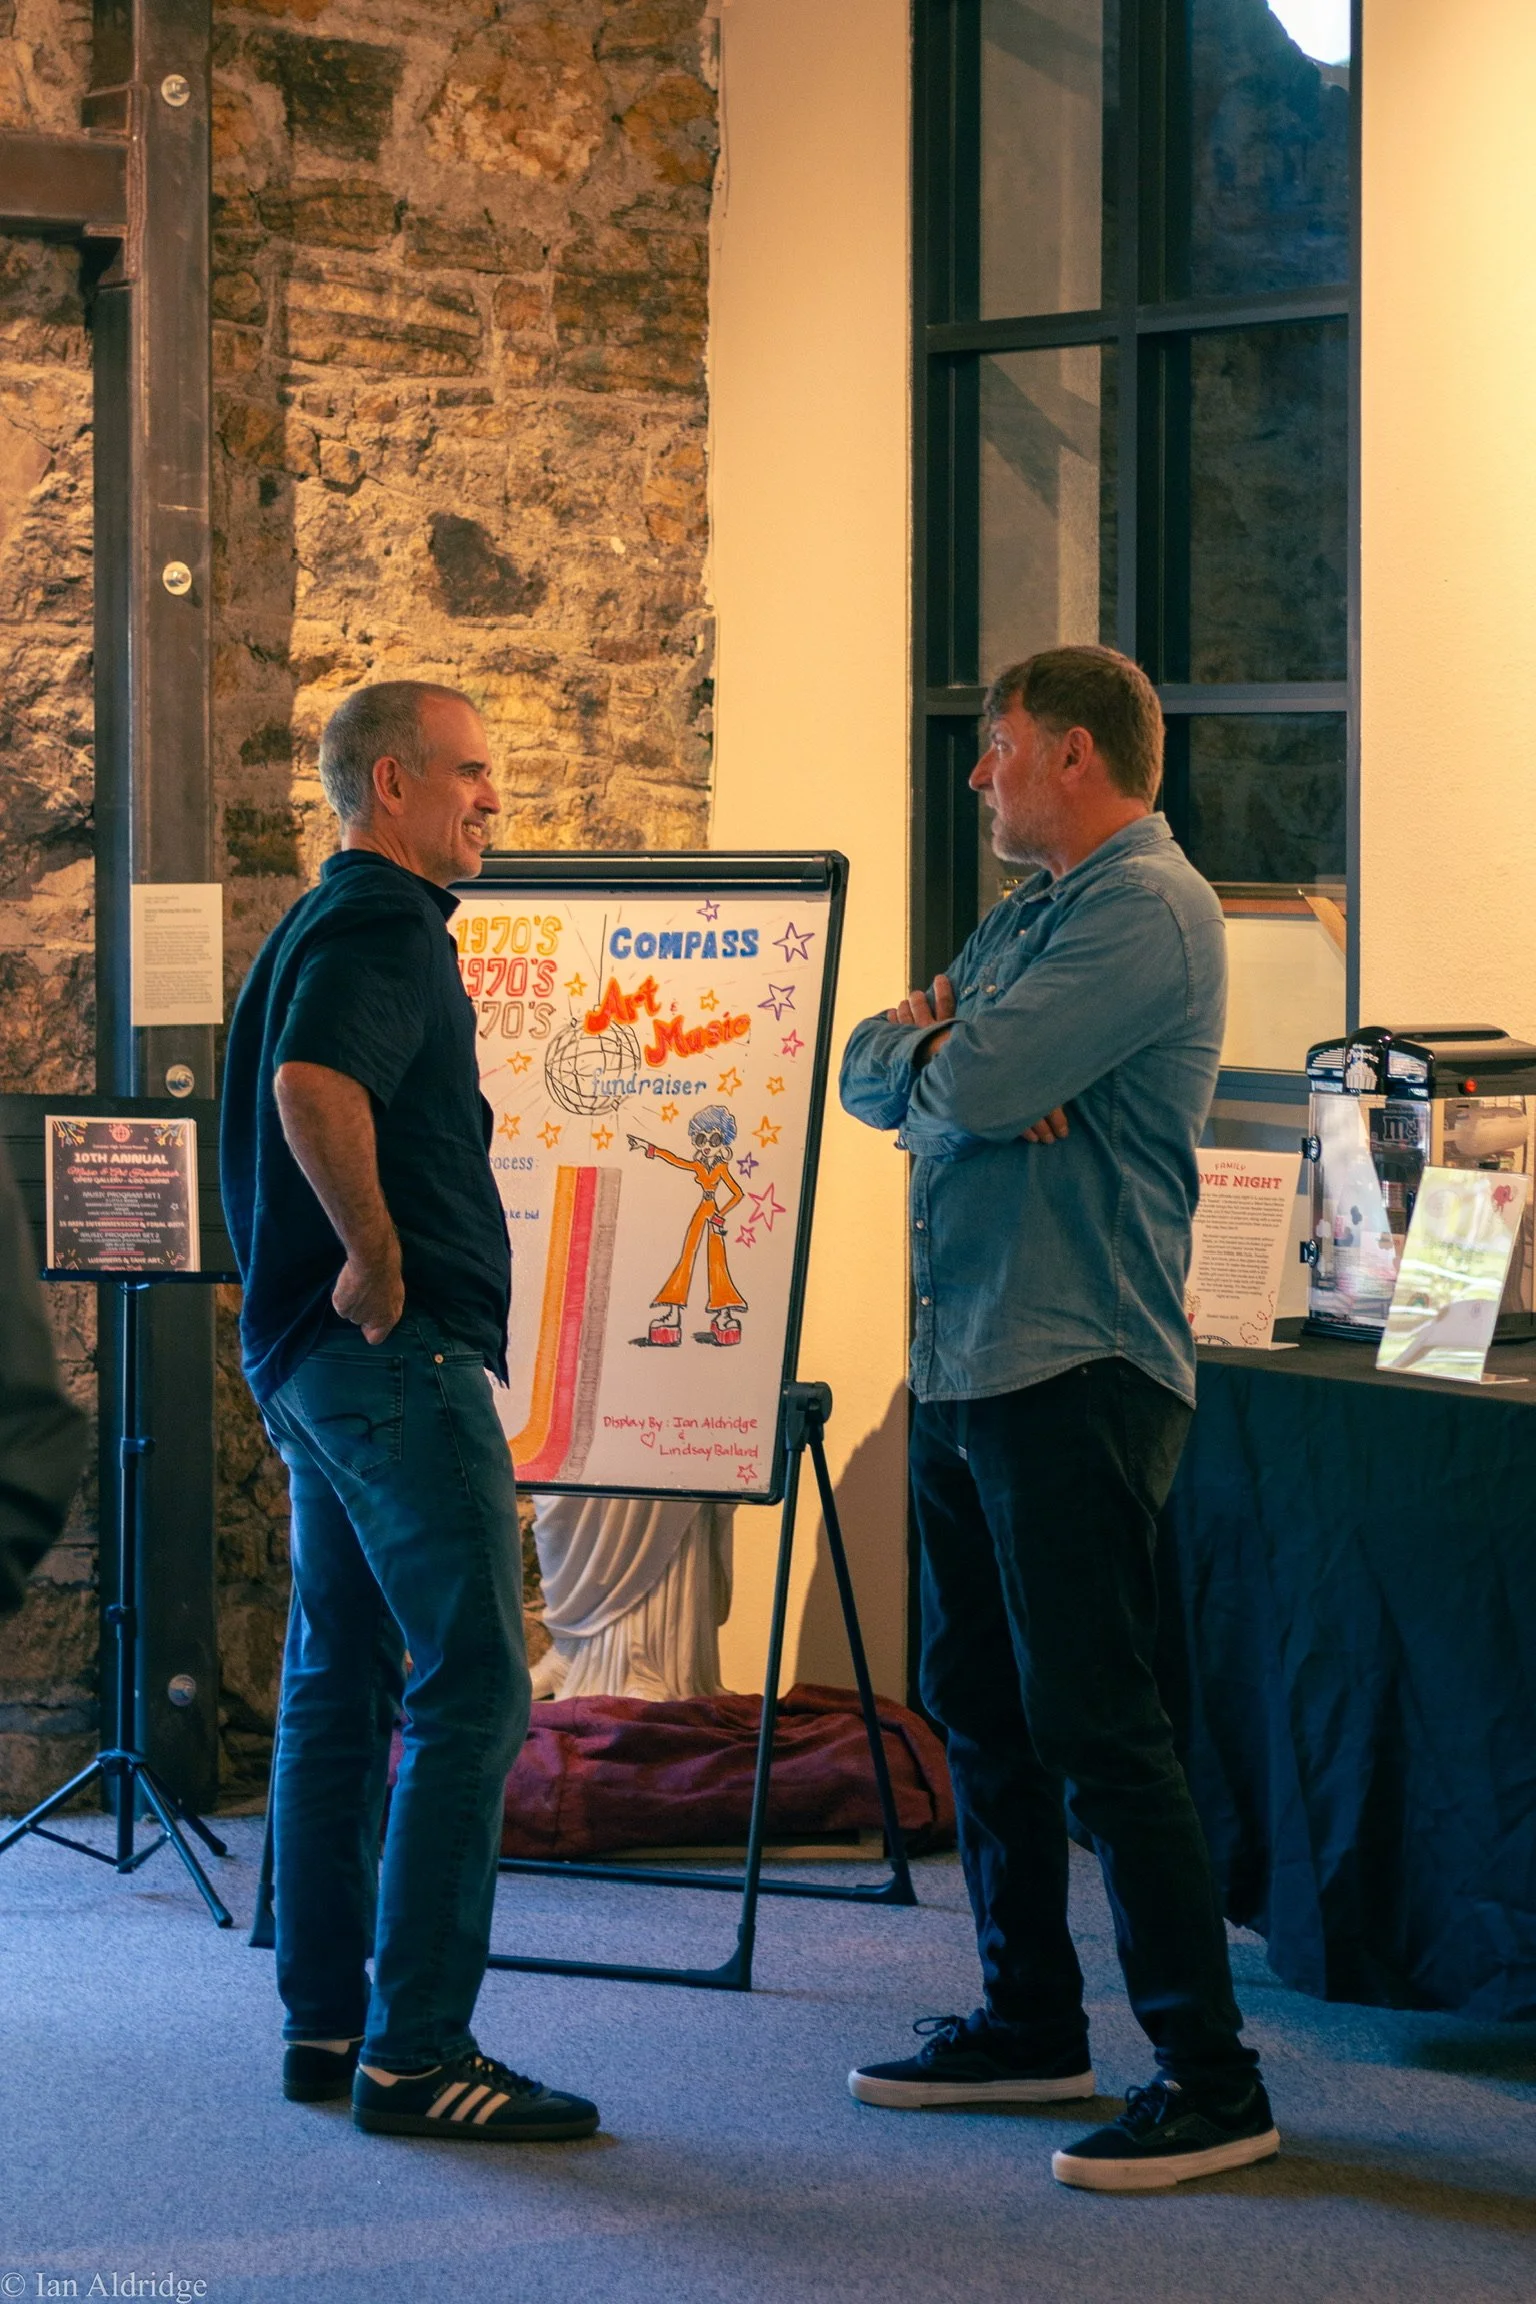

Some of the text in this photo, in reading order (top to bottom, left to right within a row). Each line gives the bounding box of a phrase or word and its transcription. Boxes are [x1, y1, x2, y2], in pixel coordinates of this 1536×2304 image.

[609, 927, 759, 960] COMPASS
[476, 1000, 557, 1040] 70'S
[584, 975, 661, 1034] Art
[644, 1011, 751, 1067] Music
[592, 1067, 708, 1097] fundraiser
[74, 1152, 168, 1165] 10TH ANNUAL
[492, 1156, 540, 1170] ocess:
[1215, 1162, 1247, 1171] FAMILY
[1233, 1175, 1283, 1190] NIGHT
[603, 1416, 645, 1430] Display
[673, 1416, 698, 1429] Ian
[701, 1416, 758, 1434] Aldridge
[660, 1444, 758, 1461] Lindsay Ballard
